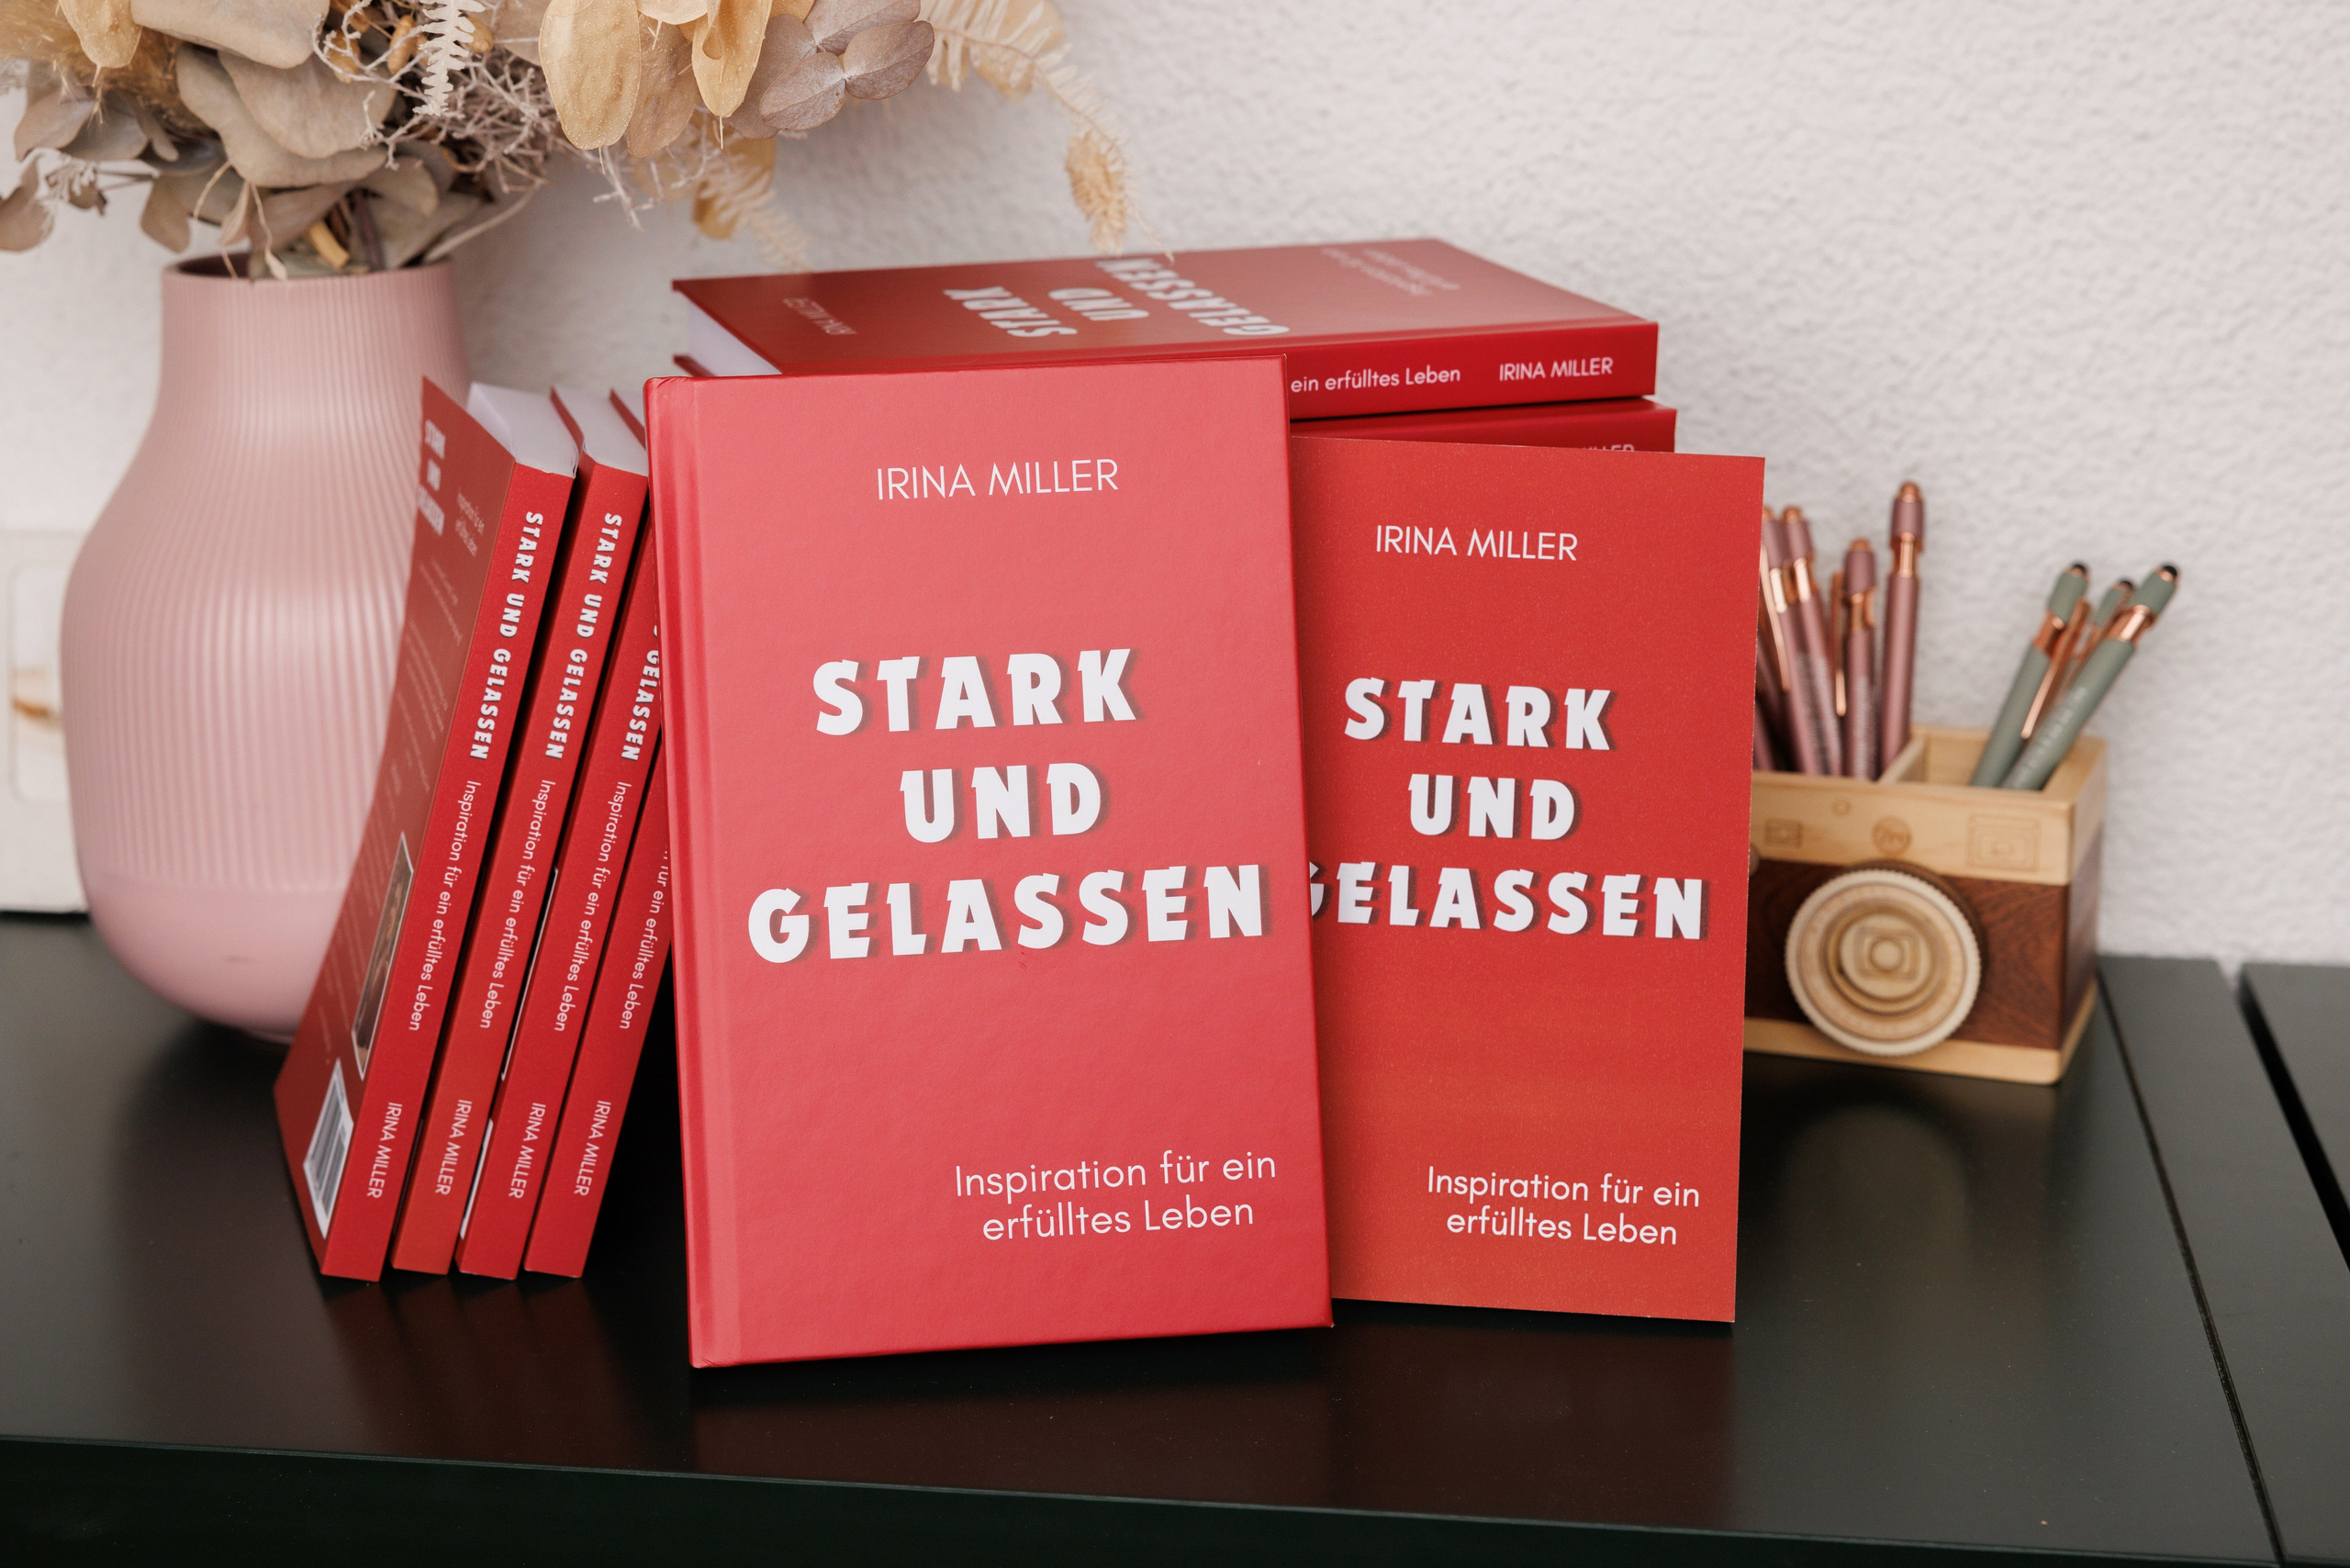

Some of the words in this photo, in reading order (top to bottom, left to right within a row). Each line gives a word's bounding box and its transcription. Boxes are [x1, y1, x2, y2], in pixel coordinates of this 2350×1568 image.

[1290, 375, 1319, 393] ein
[1325, 368, 1400, 391] erfülltes
[1405, 364, 1460, 386] Leben
[1499, 361, 1546, 382] IRINA
[1550, 356, 1614, 378] MILLER
[877, 463, 976, 500] IRINA
[988, 458, 1119, 496] MILLER
[511, 510, 543, 583] STARK
[589, 512, 622, 584] STARK
[1376, 524, 1458, 556] IRINA
[1467, 528, 1578, 561] MILLER
[499, 593, 525, 637] UND
[576, 593, 602, 638] UND
[470, 648, 511, 759] GELASSEN
[544, 648, 588, 759] GELASSEN
[621, 650, 660, 761] GELASSEN
[812, 648, 1136, 736] STARK
[1344, 677, 1611, 751] STARK
[449, 780, 482, 861] Inspiration
[522, 779, 556, 860] Inspiration
[598, 781, 632, 862] Inspiration
[899, 762, 1102, 844] UND
[1407, 773, 1575, 840] UND
[442, 866, 463, 889] für
[516, 865, 536, 887] für
[591, 867, 611, 890] für
[436, 890, 452, 915] ein
[509, 890, 524, 913] ein
[584, 891, 599, 916] ein
[649, 890, 665, 914] ein
[747, 864, 1262, 964] GELASSEN
[420, 918, 446, 981] erfülltes
[492, 917, 519, 979] erfülltes
[566, 919, 593, 981] erfülltes
[632, 917, 658, 980] erfülltes
[408, 984, 433, 1031] Leben
[479, 982, 505, 1029] Leben
[554, 985, 579, 1032] Leben
[619, 983, 644, 1029] Leben
[379, 1102, 403, 1142] IRINA
[449, 1099, 473, 1138] IRINA
[522, 1102, 546, 1142] IRINA
[588, 1100, 611, 1139] IRINA
[366, 1144, 392, 1199] MILLER
[434, 1141, 461, 1195] MILLER
[509, 1144, 532, 1198] MILLER
[575, 1141, 599, 1195] MILLER
[956, 1160, 1147, 1204] Inspiration
[1159, 1149, 1210, 1184] für
[1222, 1151, 1276, 1181] ein
[1427, 1165, 1589, 1207] Inspiration
[1600, 1172, 1644, 1204] für
[1652, 1182, 1699, 1207] ein
[983, 1198, 1130, 1240] erfülltes
[1144, 1193, 1253, 1231] Leben
[1447, 1208, 1572, 1240] erfülltes
[1583, 1213, 1677, 1246] Leben
